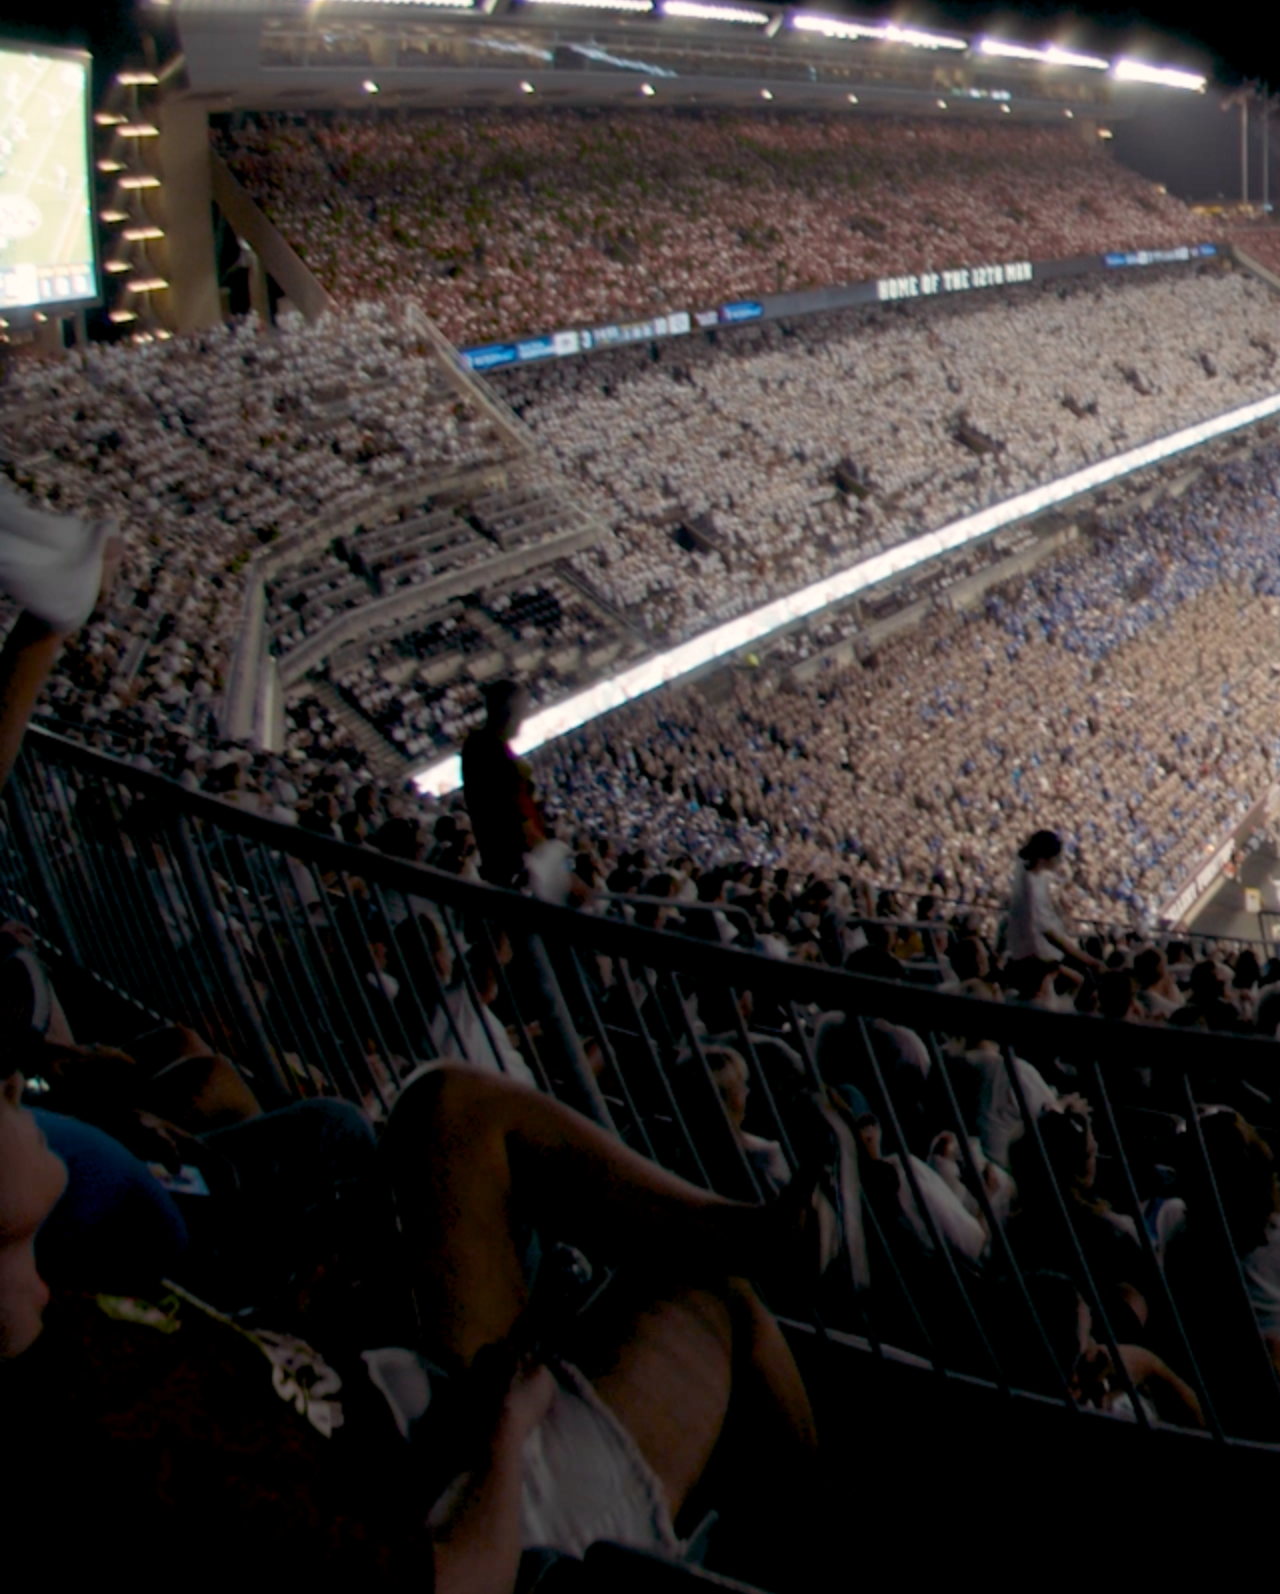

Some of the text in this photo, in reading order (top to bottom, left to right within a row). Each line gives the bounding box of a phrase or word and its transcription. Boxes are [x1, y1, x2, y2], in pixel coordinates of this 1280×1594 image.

[877, 276, 919, 301] HOME
[920, 273, 939, 295] OF
[942, 269, 970, 291] THE
[1004, 262, 1032, 282] MAN
